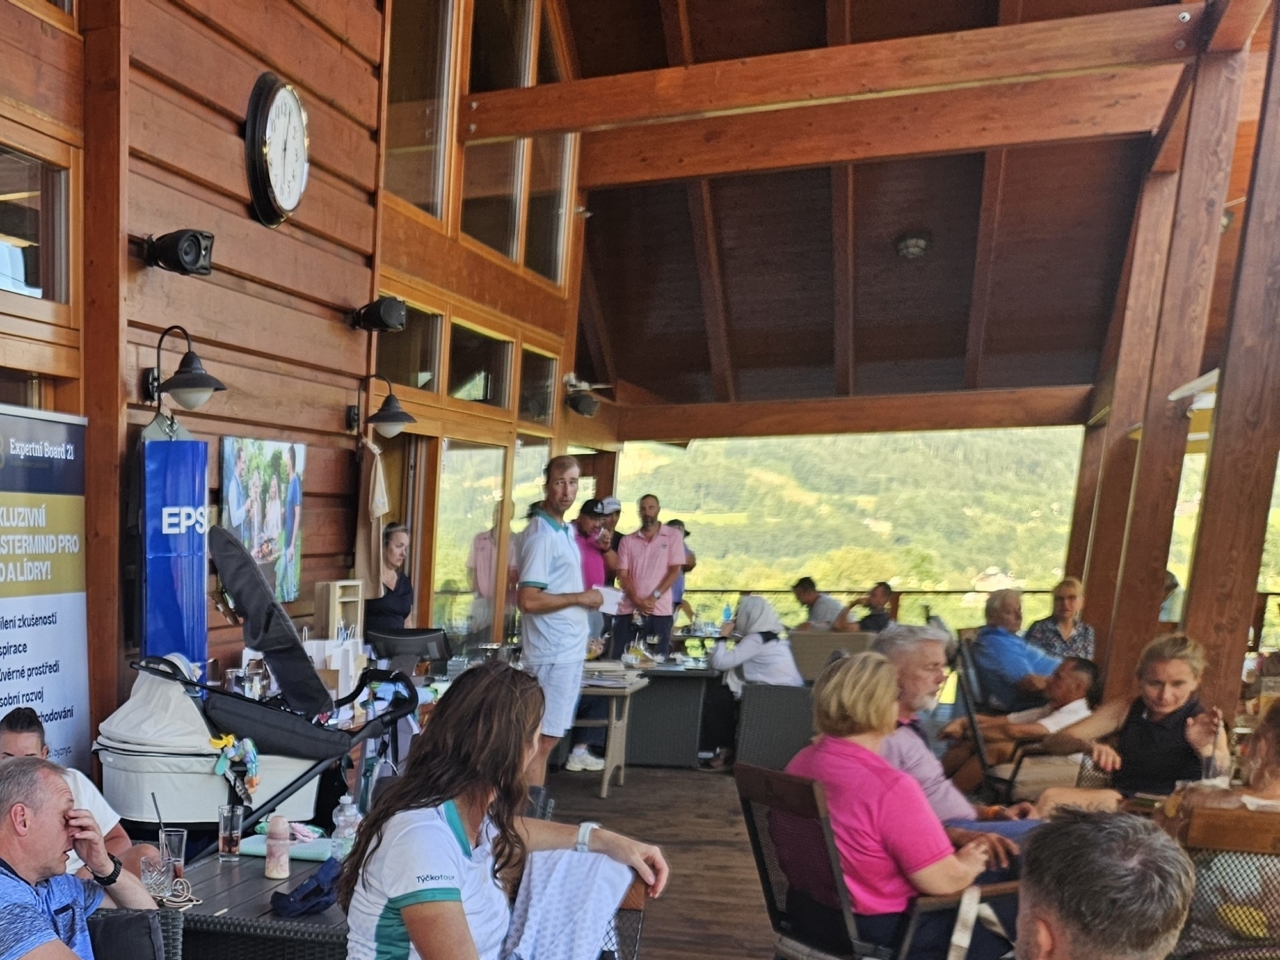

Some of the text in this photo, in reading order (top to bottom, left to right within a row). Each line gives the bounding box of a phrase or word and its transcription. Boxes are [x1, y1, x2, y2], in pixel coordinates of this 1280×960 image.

[9, 438, 43, 459] Expertní
[44, 442, 65, 459] Board
[58, 534, 79, 554] PRO
[7, 564, 16, 582] A
[17, 558, 52, 582] LÍDRY!
[27, 660, 59, 681] prostředí
[21, 686, 44, 703] rozvoj
[37, 705, 74, 724] hodování
